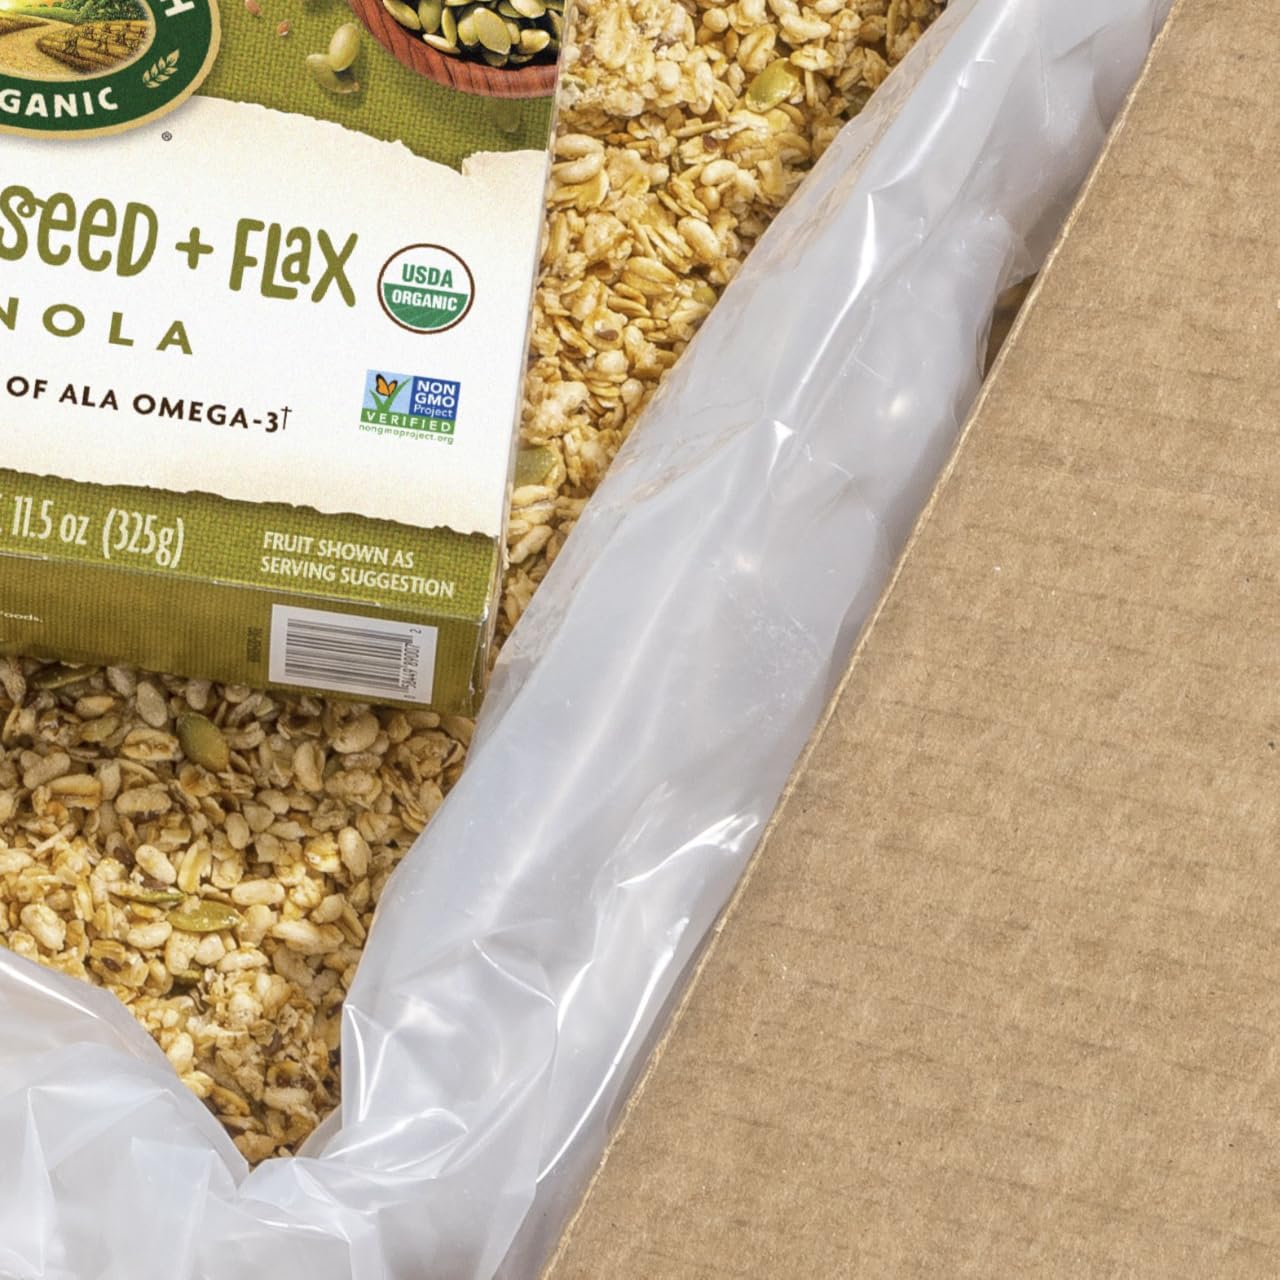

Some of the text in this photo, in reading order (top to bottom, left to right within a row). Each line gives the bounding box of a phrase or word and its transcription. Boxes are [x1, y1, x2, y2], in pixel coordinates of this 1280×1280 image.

[175, 226, 214, 270] +
[402, 263, 454, 288] USDA
[391, 288, 458, 312] ORGANIC
[6, 376, 48, 400] OF
[59, 384, 119, 411] ALA
[415, 392, 455, 408] GMO
[417, 380, 456, 396] NON
[365, 411, 453, 433] VERIFIED
[413, 404, 454, 419] Project
[358, 423, 455, 446] nongmoproject.org
[12, 494, 54, 540] 11.5
[59, 513, 90, 545] oz
[102, 507, 185, 569] (325g)
[263, 531, 415, 569] FRUIT SHOWN AS
[260, 556, 455, 598] SERVING SUGGESTION
